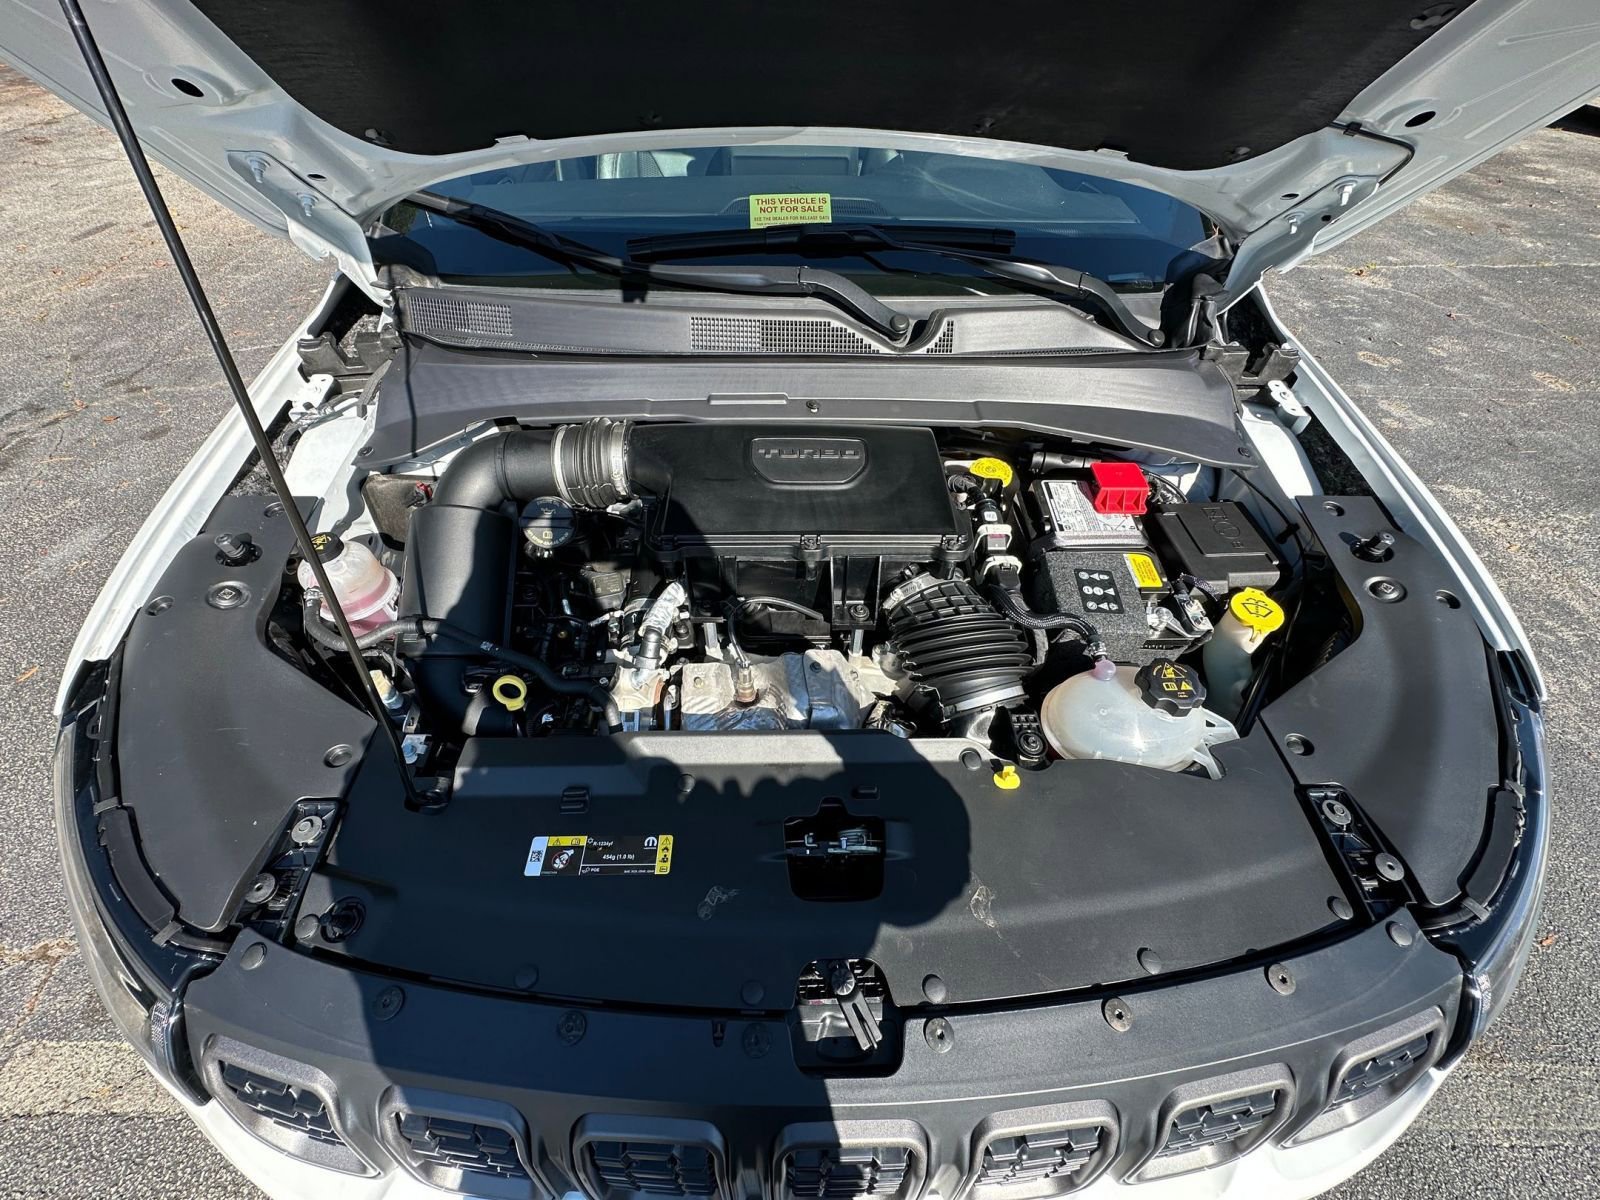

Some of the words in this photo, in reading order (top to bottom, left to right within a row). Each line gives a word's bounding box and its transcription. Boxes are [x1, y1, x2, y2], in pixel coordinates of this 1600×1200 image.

[778, 197, 816, 205] VEHICLE
[759, 206, 778, 214] NOT
[780, 205, 798, 213] FOR
[801, 205, 824, 213] SALE
[758, 449, 860, 459] TURBO
